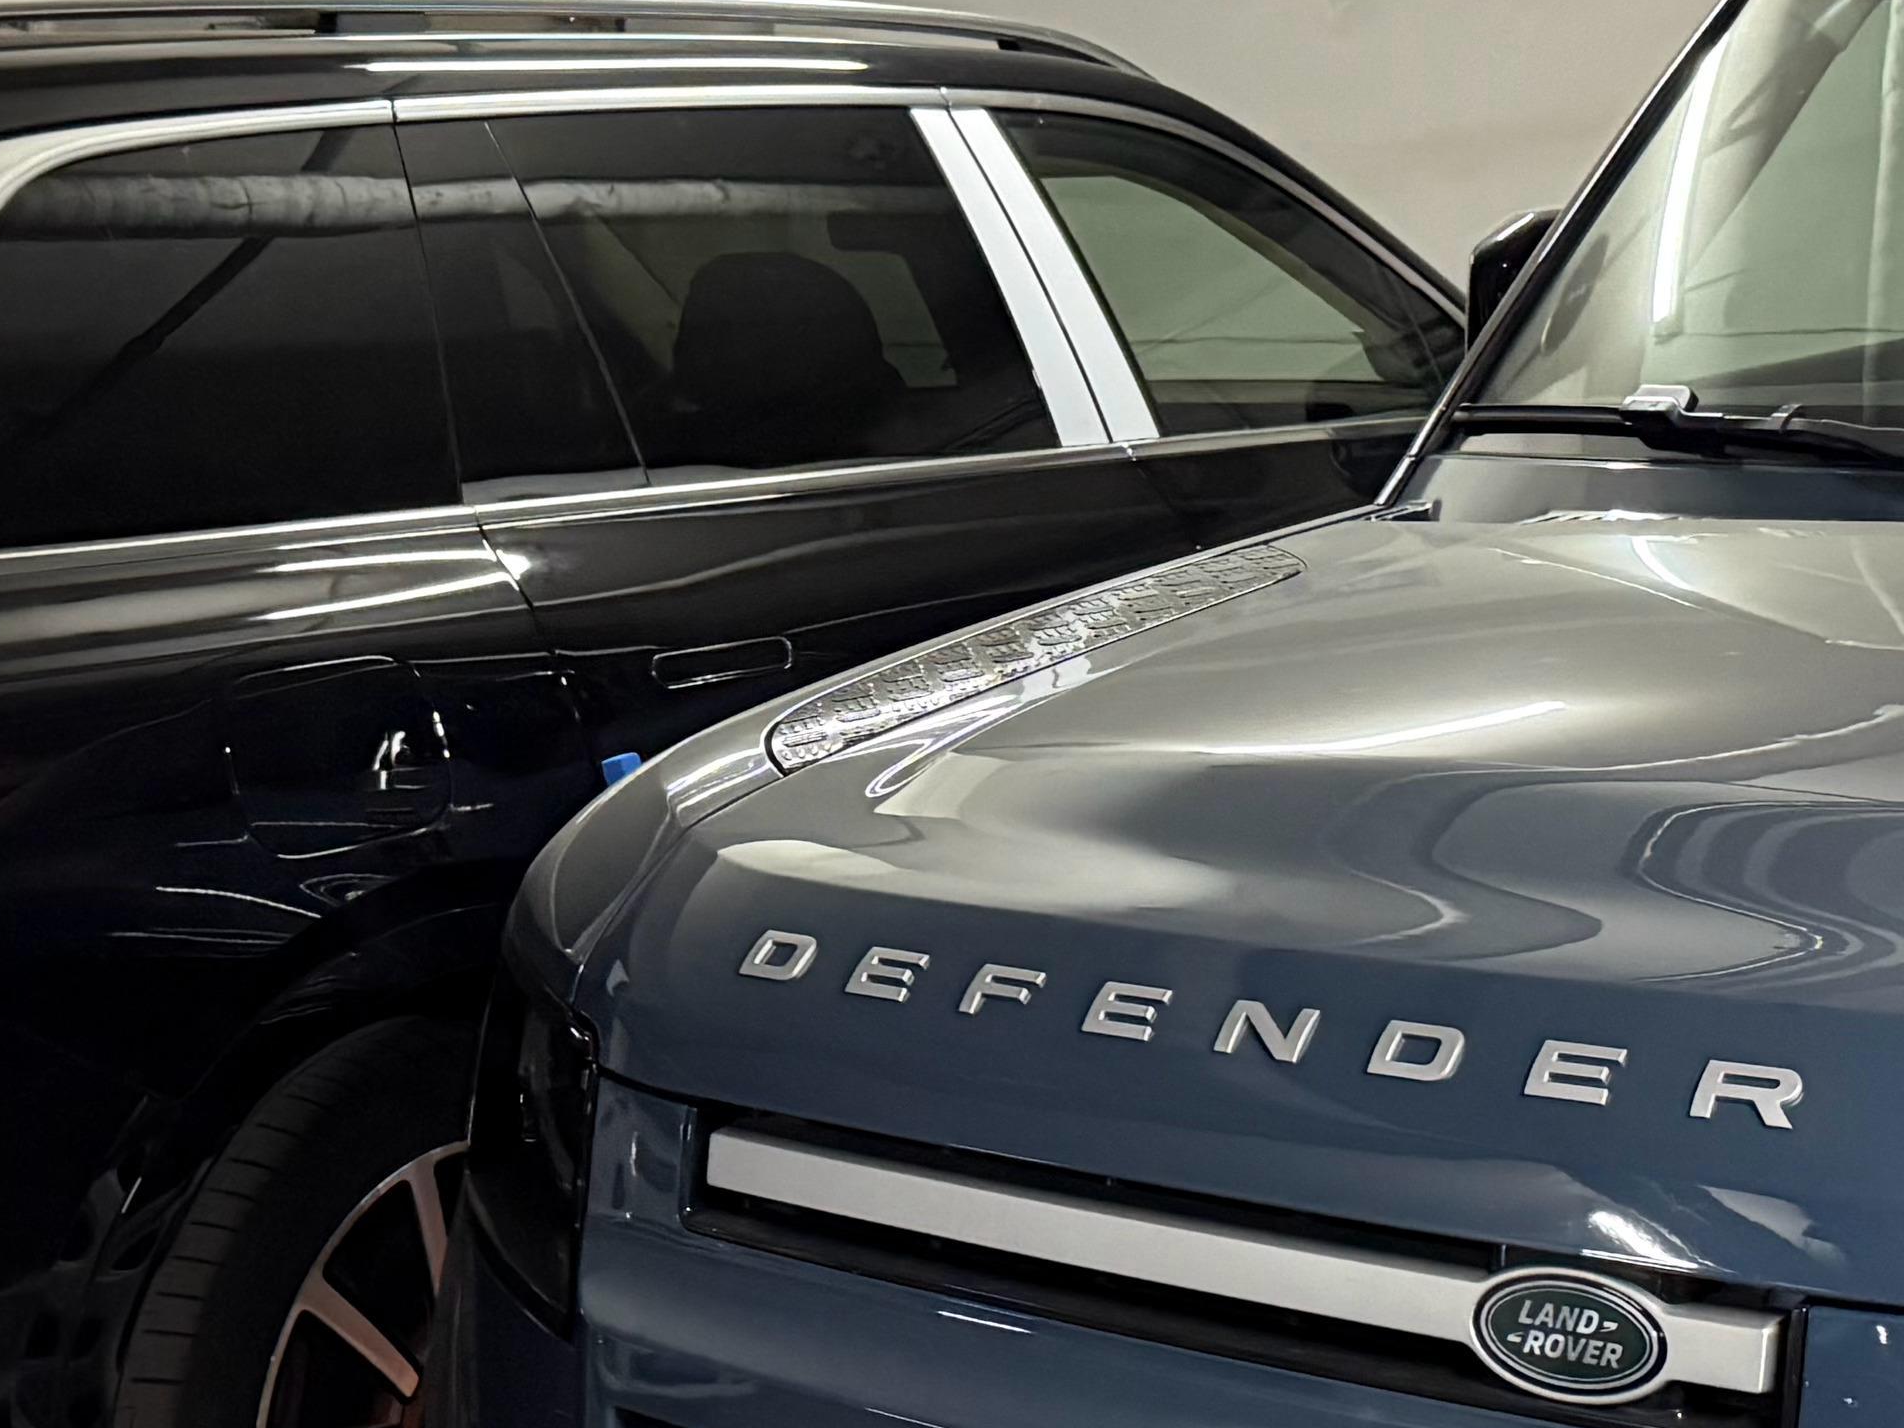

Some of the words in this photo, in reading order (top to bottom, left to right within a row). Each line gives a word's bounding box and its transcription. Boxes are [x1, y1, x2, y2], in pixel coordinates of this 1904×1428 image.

[739, 929, 1805, 1129] DEFENDER
[1518, 1299, 1599, 1335] LAND
[1523, 1329, 1625, 1369] ROVER
